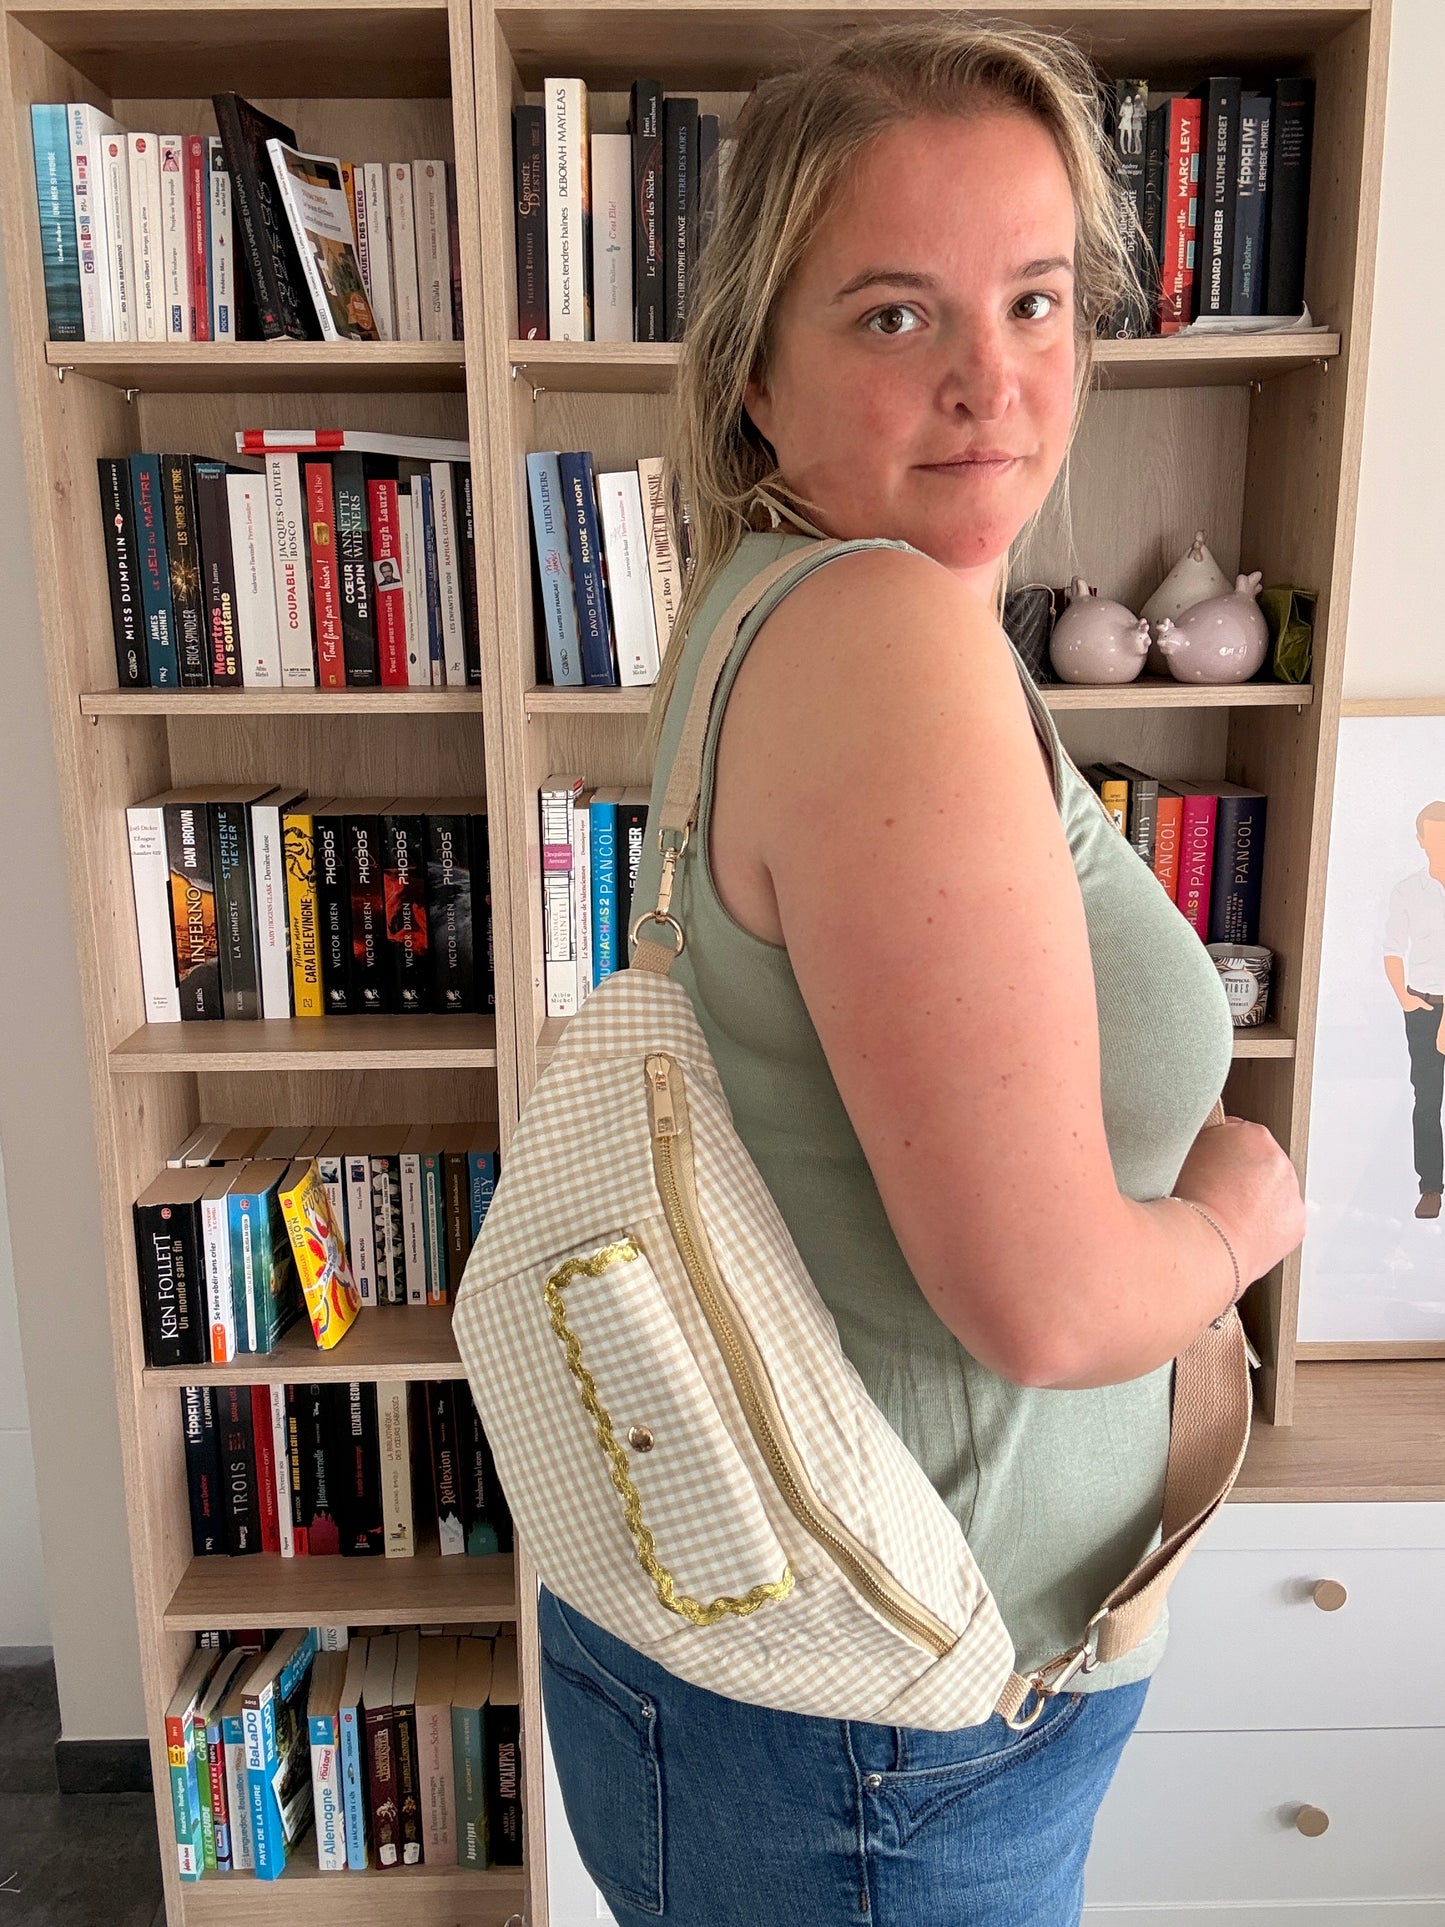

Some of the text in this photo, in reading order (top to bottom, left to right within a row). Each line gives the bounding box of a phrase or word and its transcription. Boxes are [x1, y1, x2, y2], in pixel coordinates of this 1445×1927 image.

[1238, 118, 1258, 196] L'ÉPREUVE
[1258, 119, 1269, 191] LE MORTEL
[50, 185, 58, 200] MER
[356, 190, 364, 219] GEEKS
[556, 89, 571, 315] Douces, tendres haines DEBORAH MAYLEAS
[679, 199, 686, 209] LA
[1173, 118, 1190, 315] Une fille comme elle MARC LEVY
[1211, 115, 1228, 309] BERNARD WERBER L'ULTIME SECRET
[646, 170, 656, 276] Le Testament des Siècles
[678, 250, 687, 320] JEAN-CHRISTOPHE
[1242, 236, 1253, 298] James Dashner
[173, 305, 181, 332] POCKET
[172, 468, 187, 545] LES ANGES DE VERRE
[272, 462, 288, 557] JACQUES-OLIVIER
[340, 491, 352, 557] ANNETTE
[350, 495, 363, 557] WIENERS
[377, 484, 391, 557] Hugh Laurie
[540, 472, 555, 534] JULIEN LEPERS
[288, 521, 298, 557] BOSCO
[574, 478, 599, 636] DAVID PEACE ROUGE OU MORT
[116, 537, 131, 602] DUMPLIN
[211, 563, 220, 584] James
[344, 565, 355, 603] CŒUR
[356, 565, 368, 618] DE LAPIN
[285, 564, 298, 629] COUPABLE
[323, 605, 338, 618] par
[325, 592, 333, 603] un
[123, 608, 134, 639] MISS
[150, 615, 159, 640] JAMES
[159, 610, 169, 645] DASHNER
[183, 609, 197, 643] SPINDLER
[211, 608, 226, 674] Meurtres
[221, 593, 235, 674] en soutane
[322, 620, 339, 639] finit
[186, 645, 200, 665] ERICA
[323, 641, 337, 661] Tout
[181, 810, 197, 867] DAN BROWN
[218, 812, 231, 879] STEPHENIE
[229, 825, 239, 866] MEYER
[599, 823, 613, 893] PANCOL
[1160, 817, 1176, 888] PANCOL
[1191, 816, 1209, 885] PANCOL
[1235, 816, 1252, 883] PANCOL
[263, 854, 271, 880] Dernière
[187, 887, 205, 962] INFERNO
[230, 901, 241, 958] LA CHIMISTE
[301, 898, 317, 983] CARA DELEVINGNE
[330, 903, 339, 930] DIXEN
[364, 902, 372, 929] DIXEN
[403, 903, 411, 930] DIXEN
[447, 904, 455, 930] DIXEN
[559, 901, 567, 957] BUSHNELL
[332, 935, 341, 967] VICTOR
[365, 934, 375, 967] VICTOR
[405, 934, 414, 967] VICTOR
[449, 935, 458, 968] VICTOR
[473, 1177, 481, 1213] LUCINDA
[291, 1217, 305, 1247] HUON
[153, 1233, 178, 1340] KEN FOLLETT
[173, 1240, 189, 1329] Un monde sans fin
[211, 1276, 219, 1293] obéir
[212, 1295, 220, 1310] faire
[213, 1312, 221, 1320] Se
[187, 1387, 203, 1443] L'ÉPREUVE
[203, 1387, 211, 1419] LABYRINTHE
[351, 1403, 362, 1435] ELIZABETH
[231, 1462, 248, 1514] TROIS
[439, 1451, 456, 1504] Réflexion
[194, 1731, 207, 1761] Crète
[246, 1712, 260, 1767] BaLaDO
[430, 1714, 439, 1744] Scholes
[211, 1767, 219, 1789] YORK
[236, 1773, 246, 1811] Roussillon
[499, 1743, 516, 1799] APOCALYPSIS
[253, 1784, 266, 1865] PAYS DE LA LOIRE
[321, 1788, 337, 1855] Allemagne
